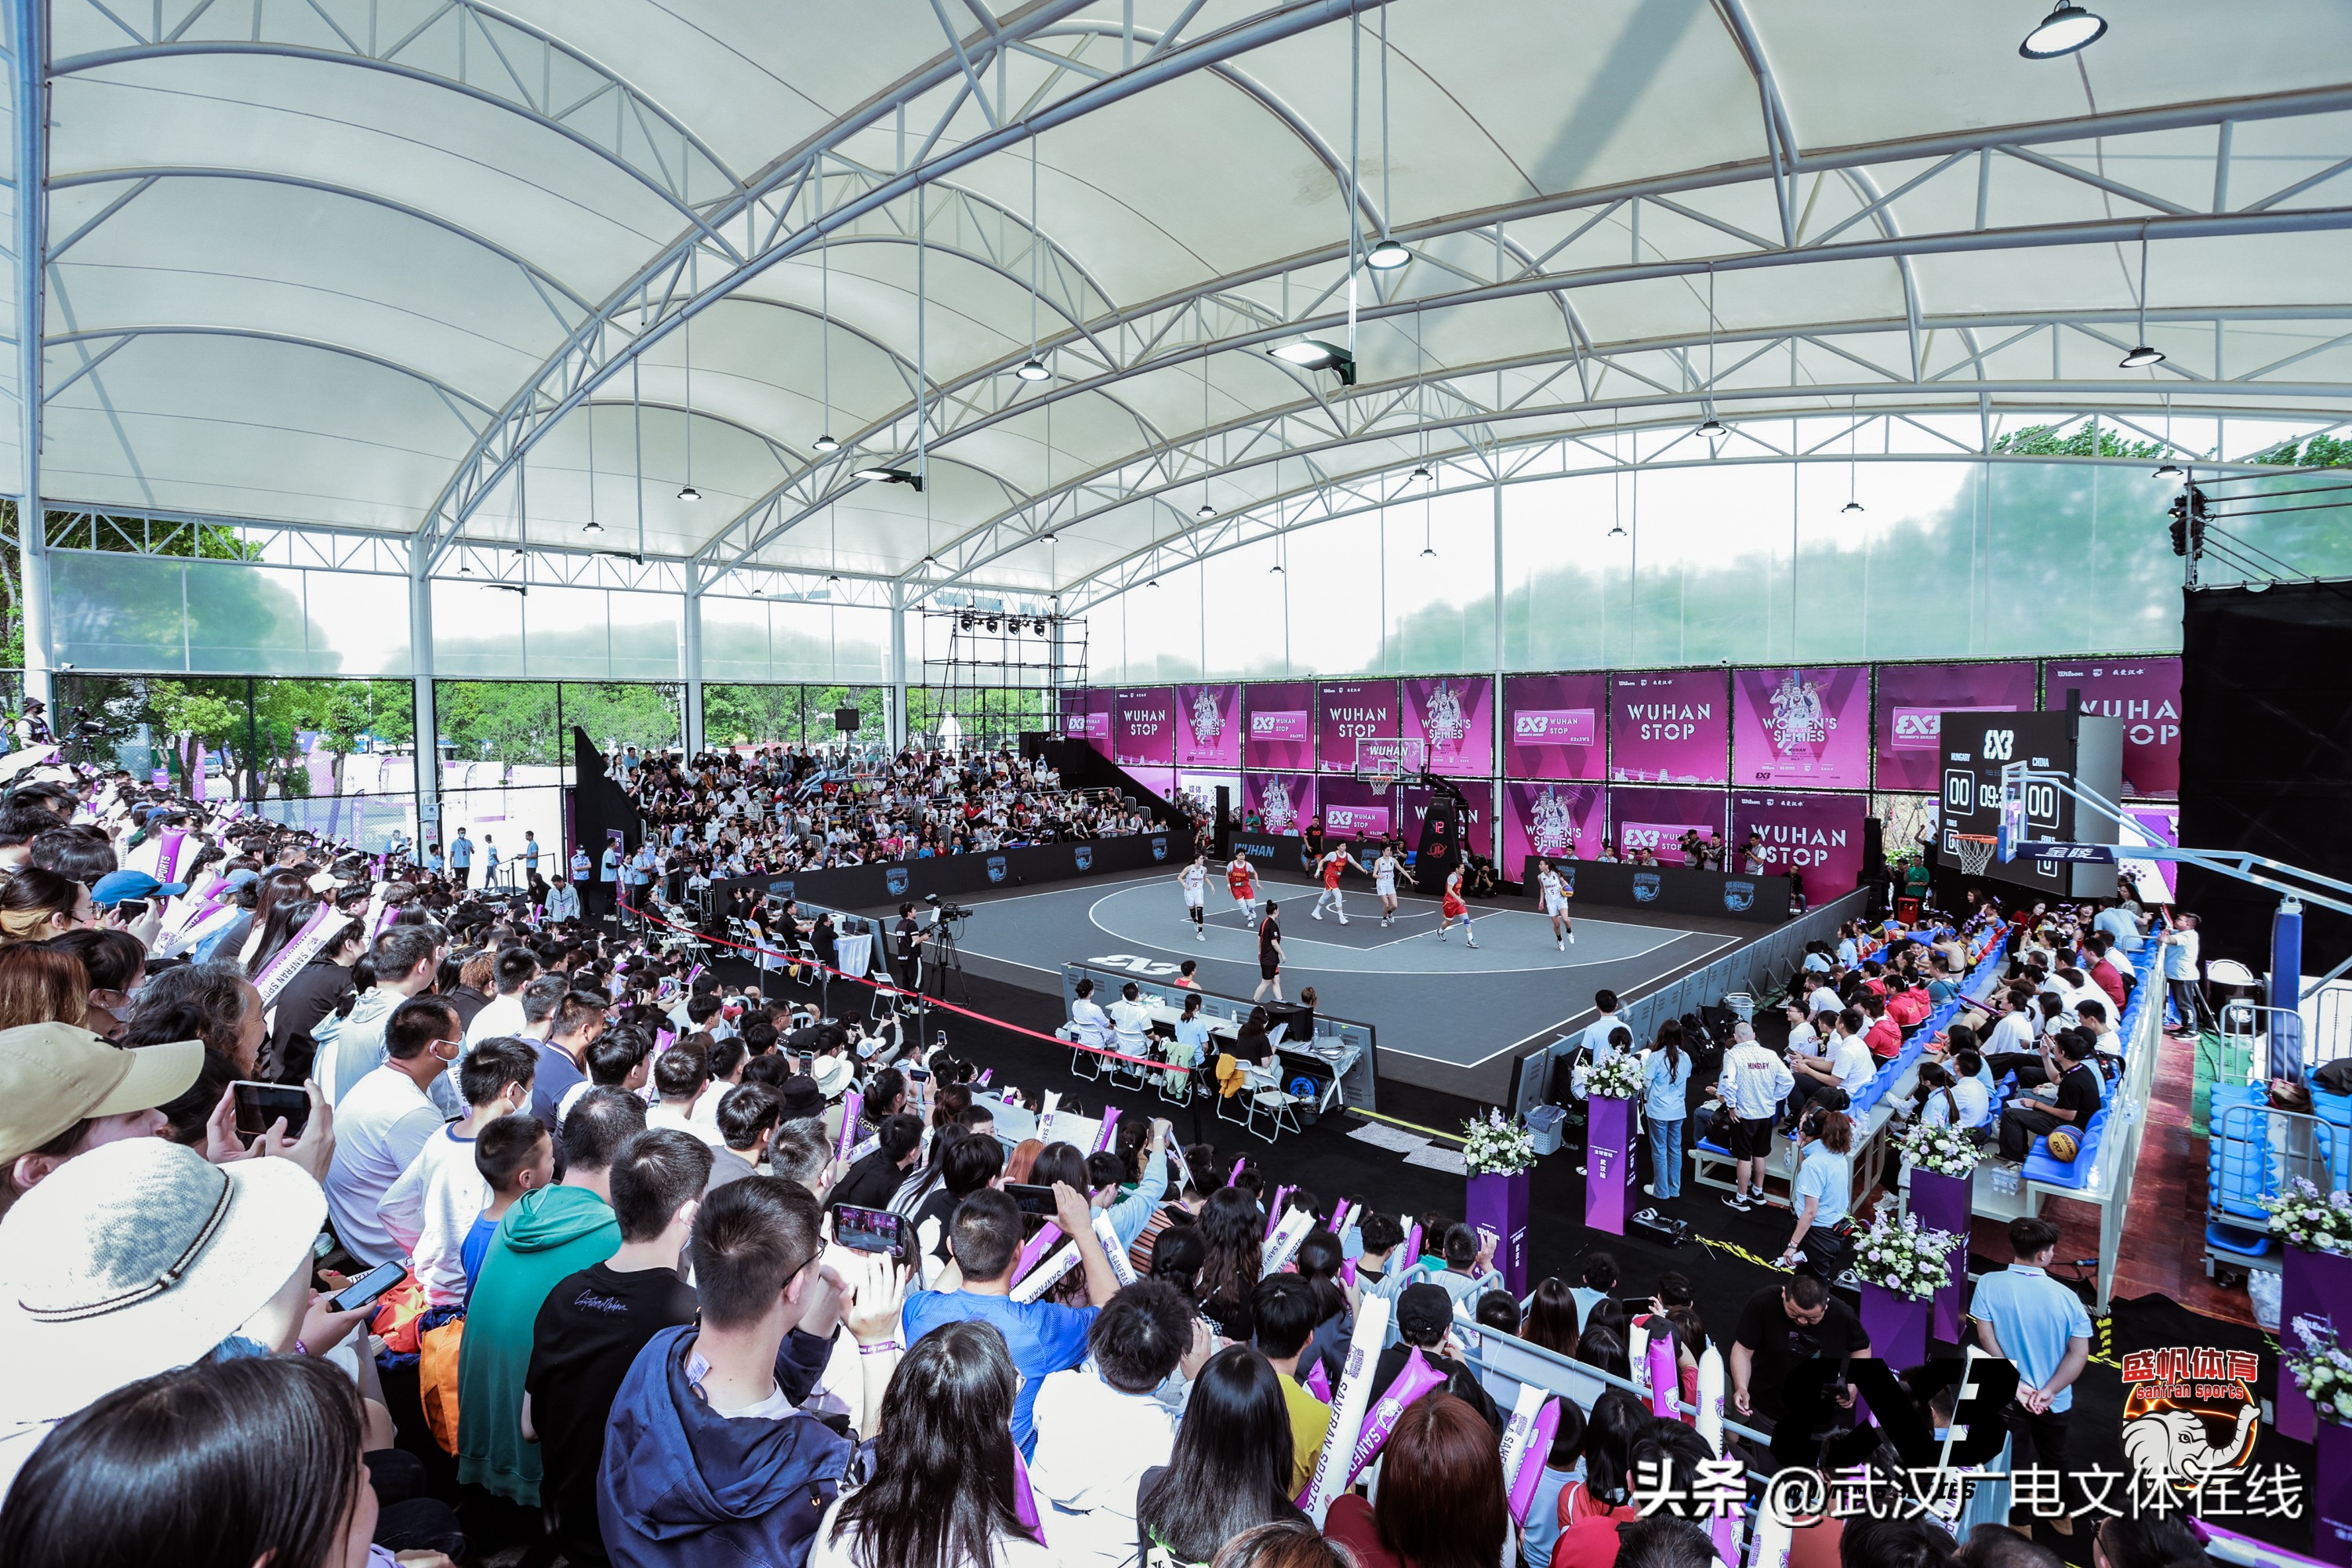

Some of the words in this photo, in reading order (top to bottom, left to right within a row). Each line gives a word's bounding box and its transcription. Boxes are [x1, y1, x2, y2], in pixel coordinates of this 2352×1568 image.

[1123, 710, 1166, 722] WUHAN
[1329, 708, 1387, 721] WUHAN
[1627, 703, 1711, 720] WUHAN
[1131, 724, 1158, 735] STOP
[1189, 719, 1225, 728] WOEN'S
[1338, 724, 1376, 738] STOP
[1421, 719, 1472, 729] WOEN'S
[1762, 717, 1838, 730] WOEN'S
[1641, 724, 1695, 740] STOP
[1773, 730, 1825, 742] SERIES
[1370, 746, 1409, 757] WUHAN
[1951, 753, 1971, 762] HUNGARY
[2032, 757, 2049, 768] CHINA
[1949, 777, 1969, 806] 00
[2027, 786, 2053, 818] 00
[1258, 807, 1298, 819] WOEN'S
[1525, 825, 1582, 839] WOEN'S
[1751, 824, 1846, 848] WUHAN
[1234, 843, 1275, 858] WUHAN
[1766, 846, 1828, 867] STOP
[156, 855, 172, 883] SPORTS
[276, 952, 308, 984] SANFRAN
[845, 1114, 855, 1140] SPORTS
[1094, 1127, 1107, 1152] SPORTS
[2060, 1134, 2074, 1155] Wilson
[1029, 1270, 1062, 1304] SANFRAN
[1321, 1381, 1348, 1450] SANFRAN
[1306, 1450, 1329, 1512] SPORTS
